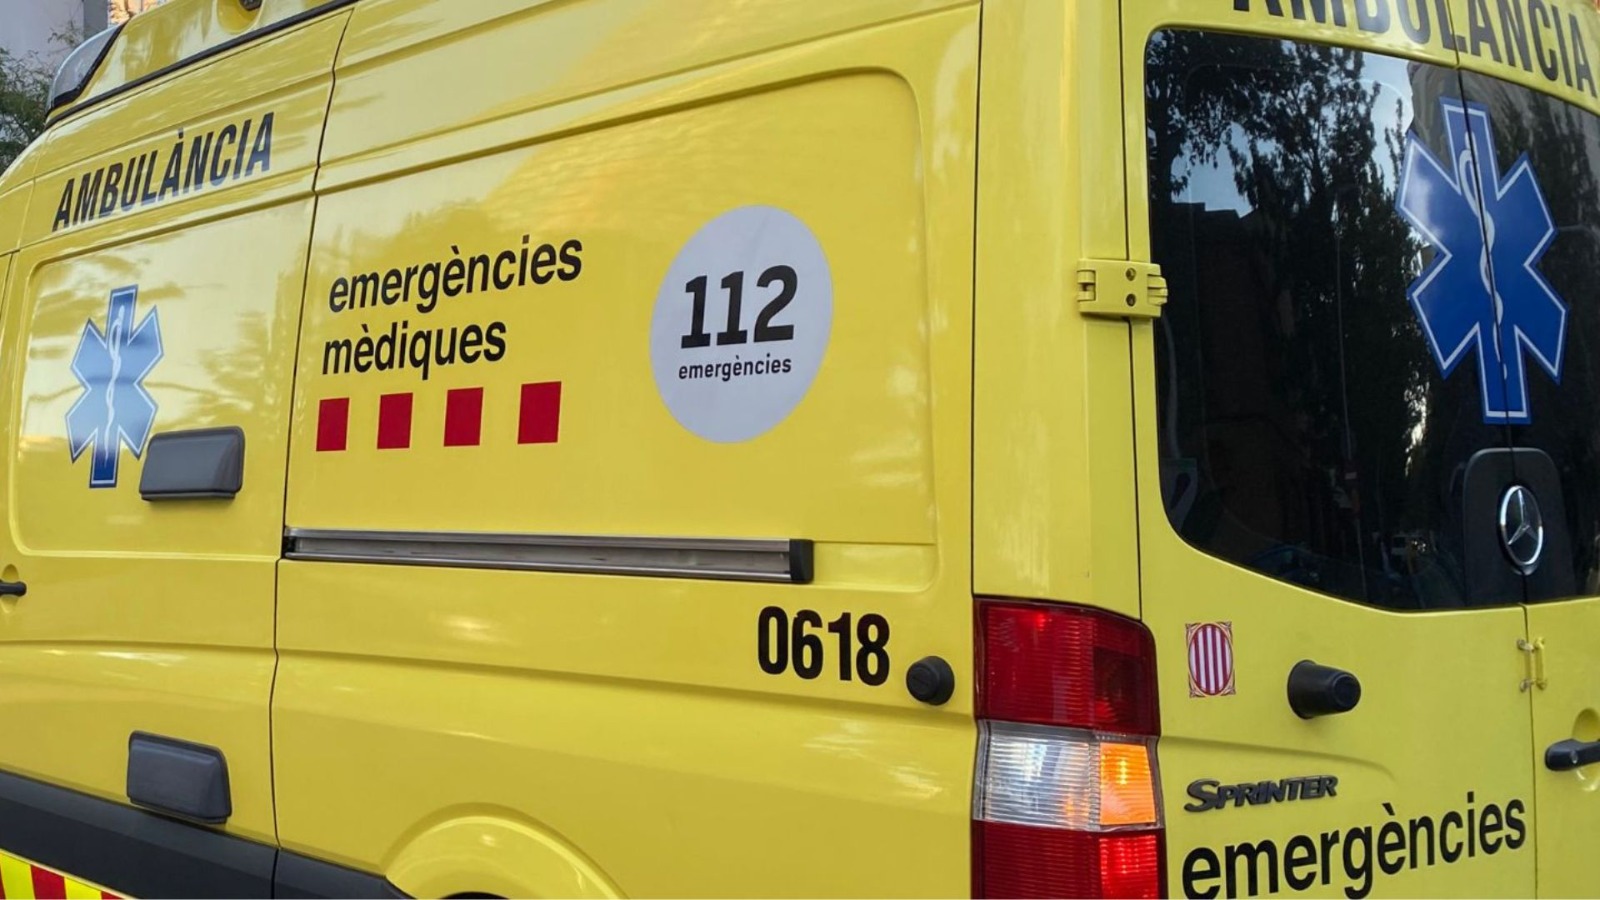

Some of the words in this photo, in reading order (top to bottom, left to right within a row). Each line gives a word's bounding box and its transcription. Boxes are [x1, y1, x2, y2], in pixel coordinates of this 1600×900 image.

[51, 112, 275, 233] AMBULÀNCIA
[329, 234, 583, 314] emergències
[679, 264, 798, 350] 112
[322, 319, 507, 381] mèdiques
[678, 352, 792, 383] emergències
[757, 605, 890, 687] 0618
[1182, 791, 1527, 900] emergències
